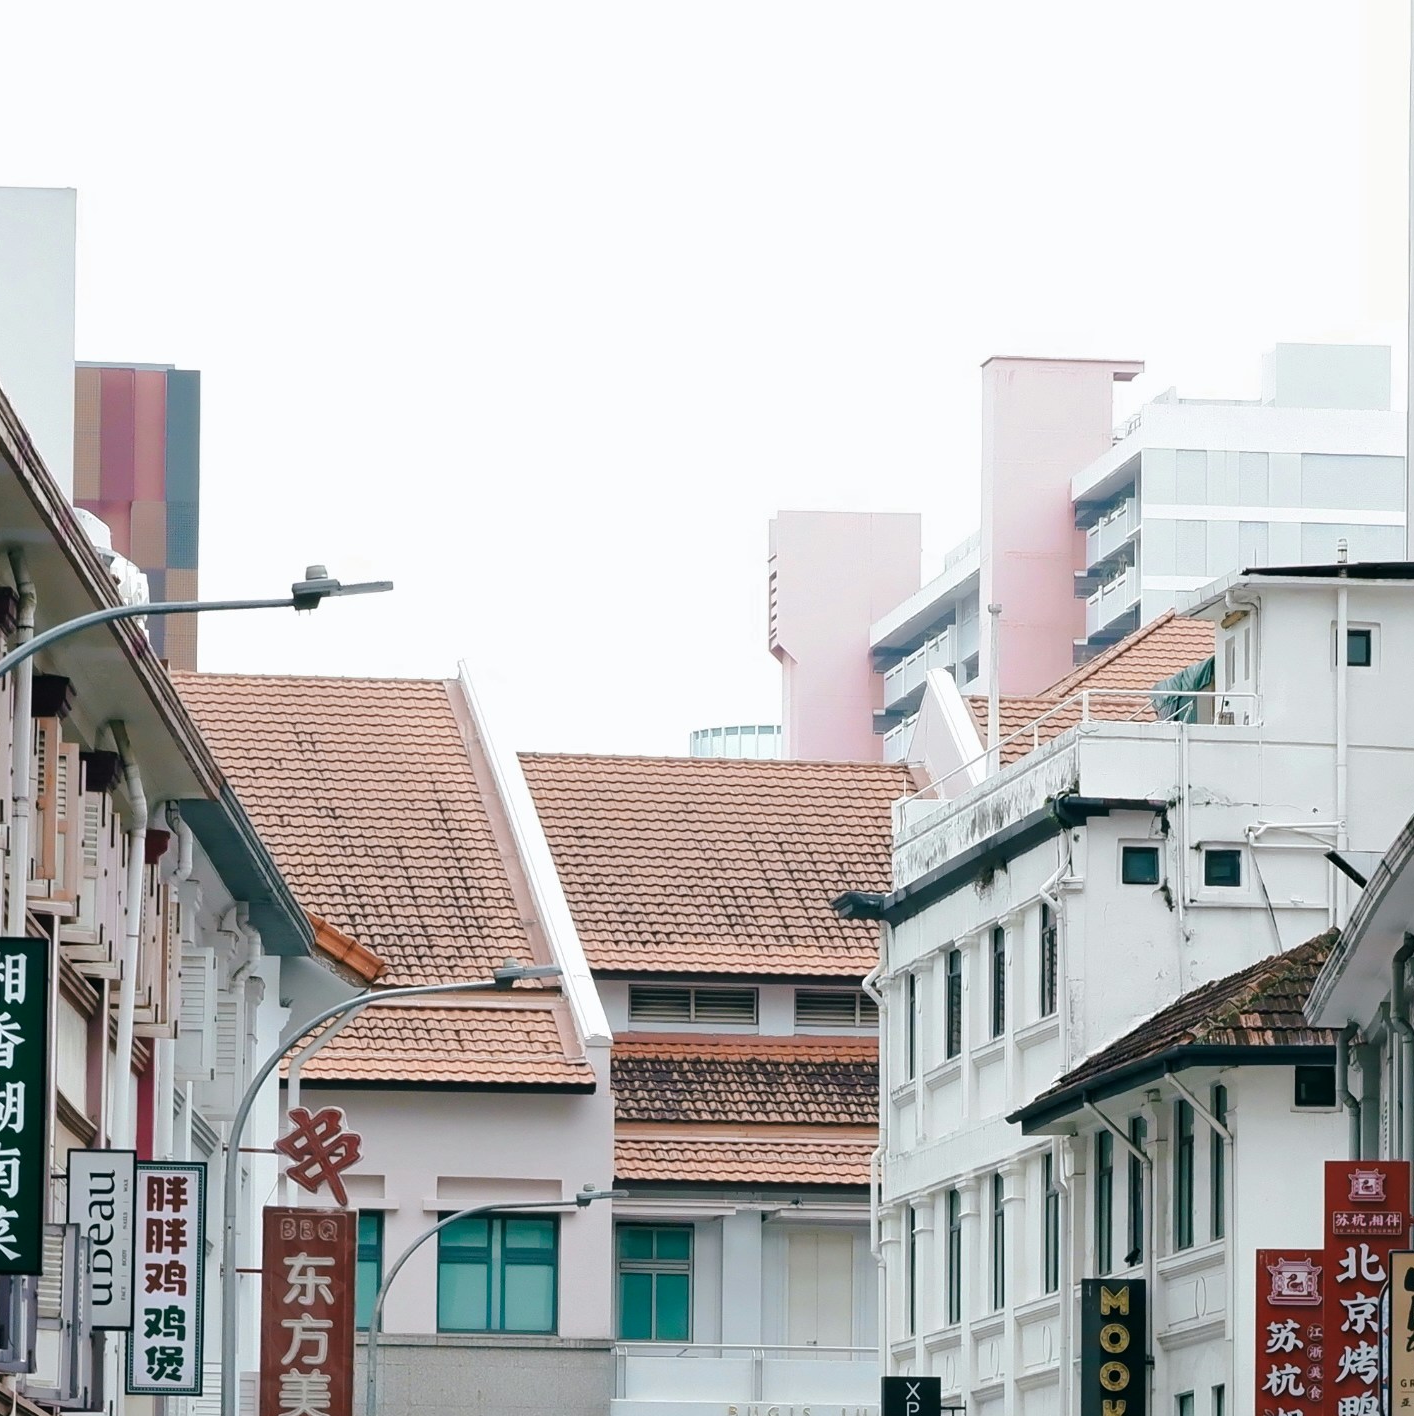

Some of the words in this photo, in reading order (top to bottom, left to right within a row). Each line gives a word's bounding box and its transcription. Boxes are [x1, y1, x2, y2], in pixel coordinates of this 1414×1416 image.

[279, 1218, 338, 1242] BBQ
[1334, 1213, 1401, 1227] 苏杭湘伴
[144, 1176, 188, 1382] 胖胖鸡鸡煲
[1307, 1323, 1323, 1401] 江浙美食
